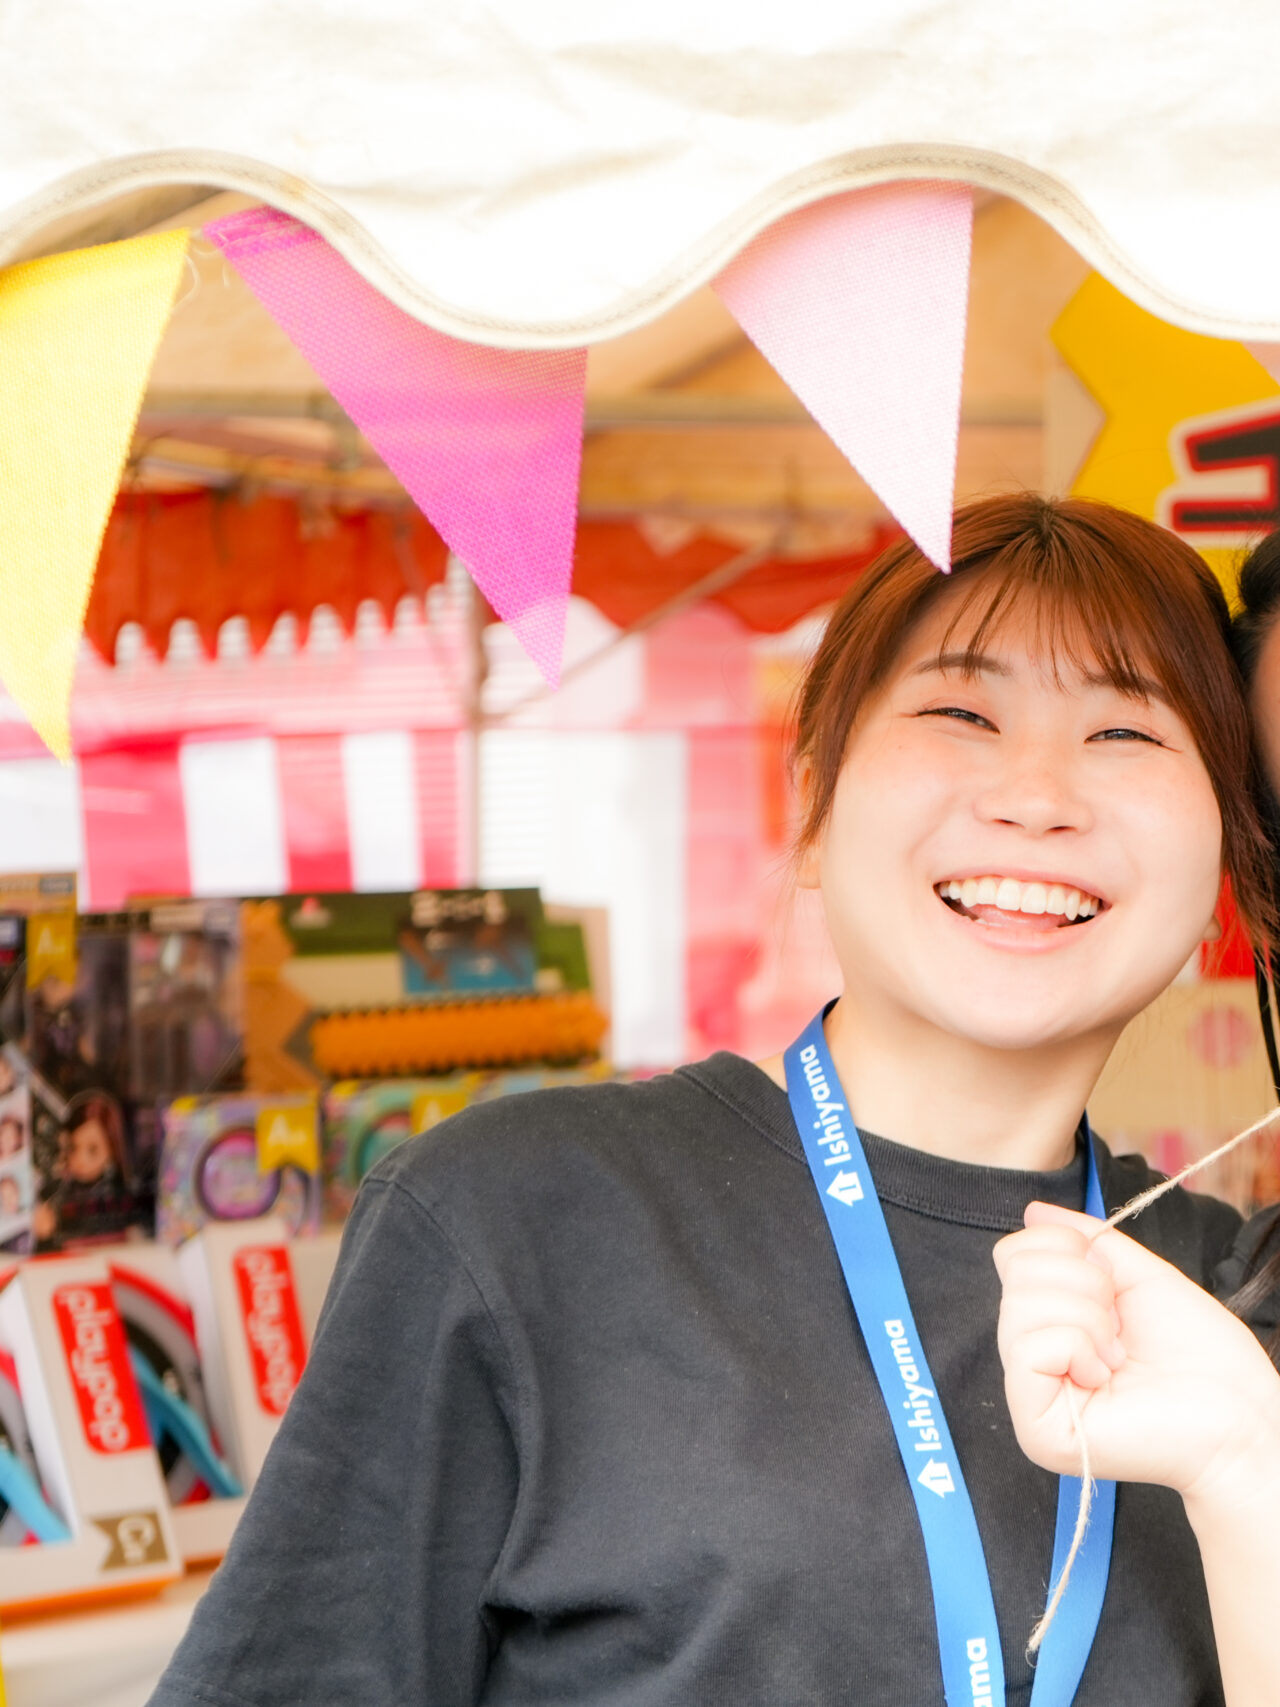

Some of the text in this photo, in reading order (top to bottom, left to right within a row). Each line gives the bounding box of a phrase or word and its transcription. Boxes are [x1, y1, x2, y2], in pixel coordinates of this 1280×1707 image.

[799, 1044, 852, 1167] Ishiyama
[61, 1289, 130, 1450] playpop
[883, 1318, 943, 1452] Ishiyama
